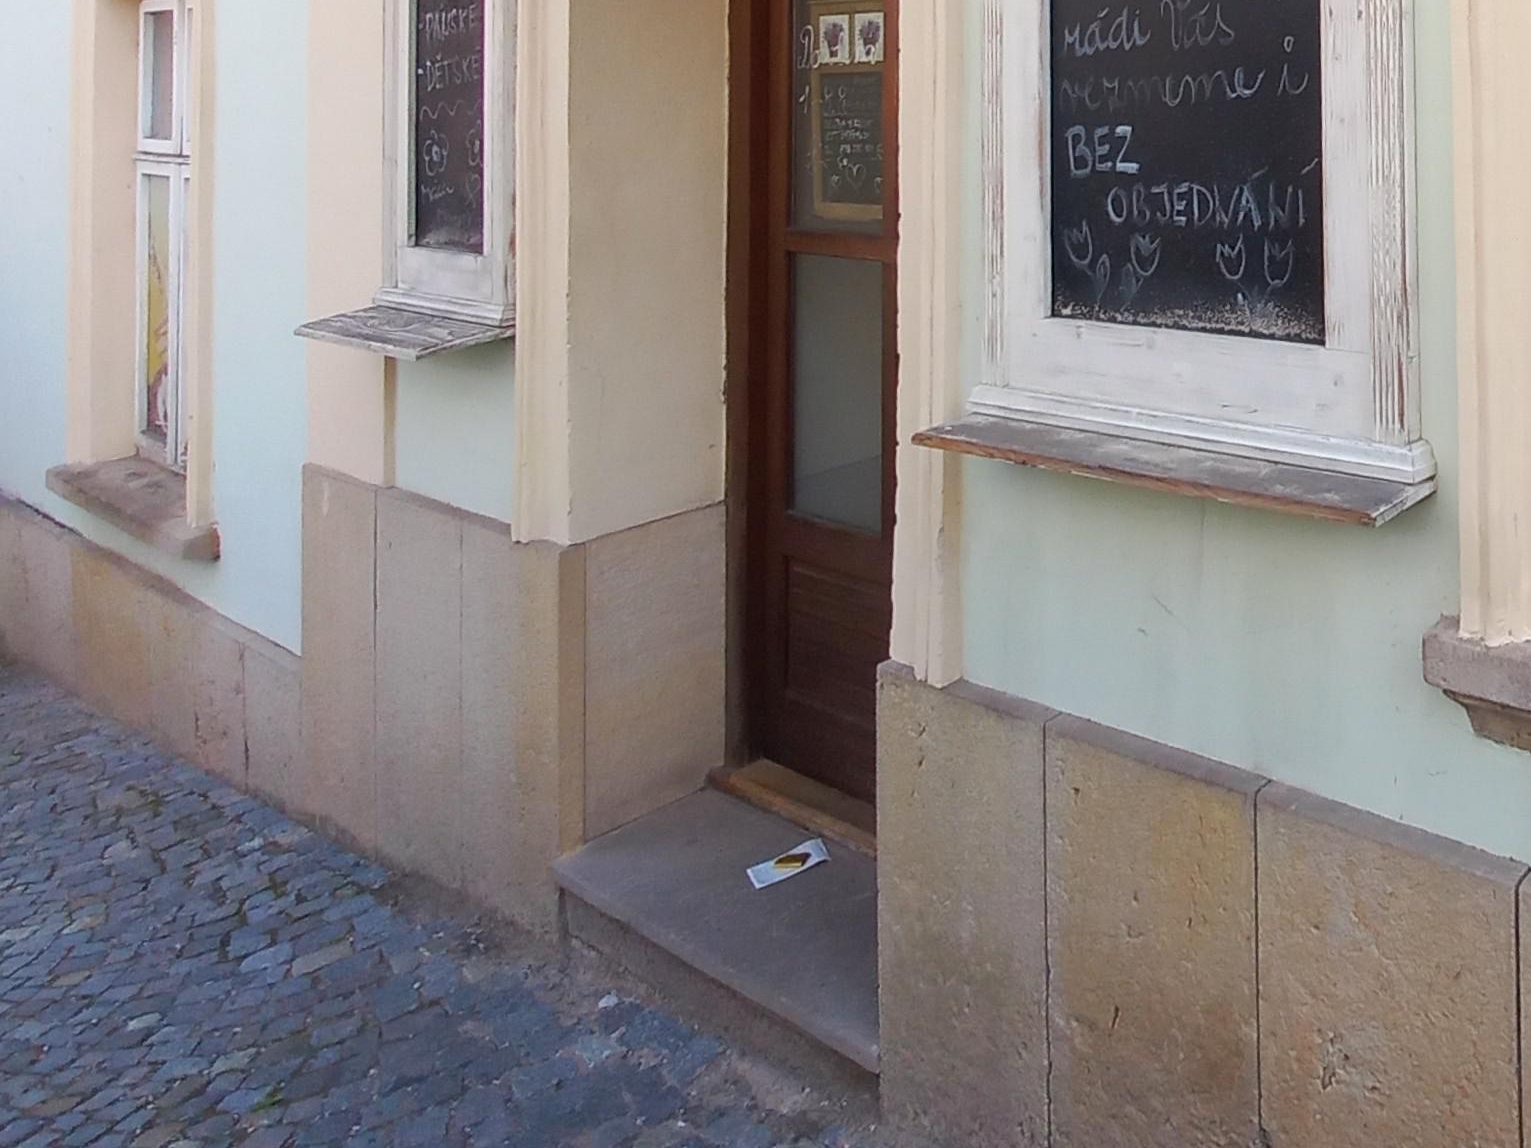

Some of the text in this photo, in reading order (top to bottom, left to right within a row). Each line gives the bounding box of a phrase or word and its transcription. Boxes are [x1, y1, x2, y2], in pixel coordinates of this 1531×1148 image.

[1063, 7, 1152, 56] rádi
[1276, 36, 1309, 97] i
[1064, 125, 1141, 179] BEZ
